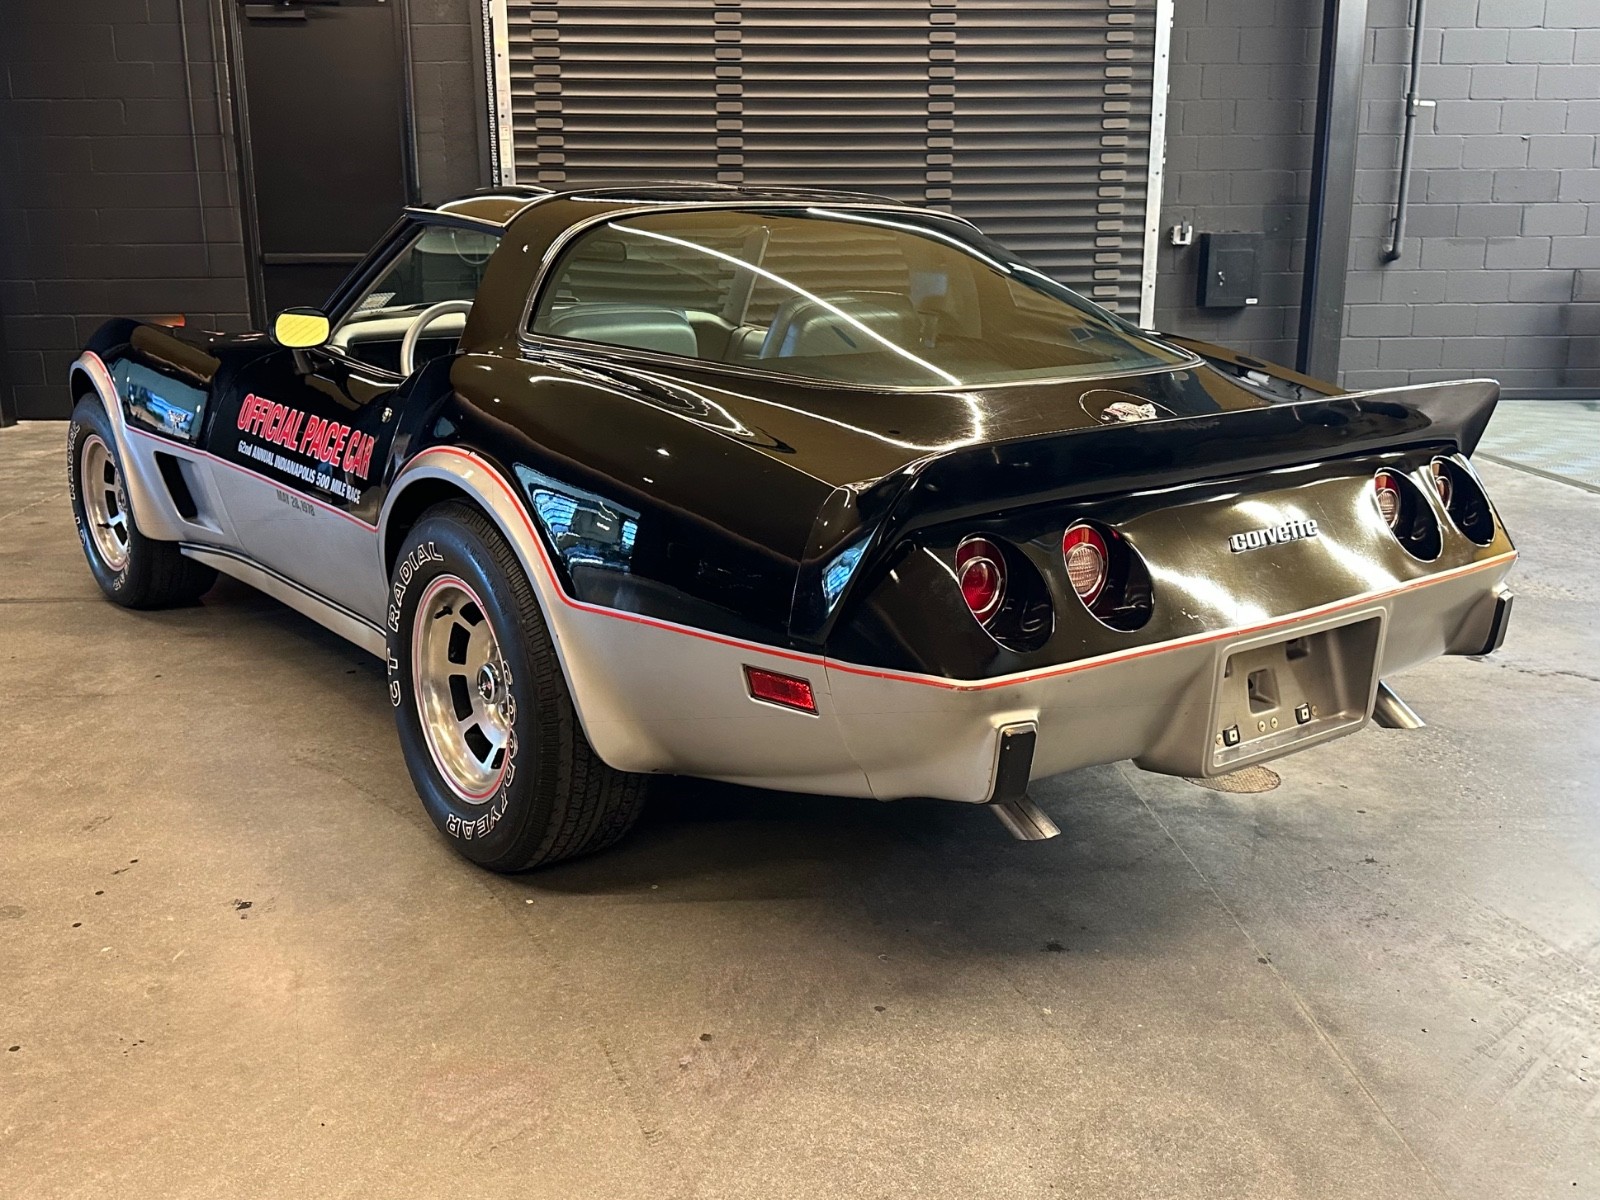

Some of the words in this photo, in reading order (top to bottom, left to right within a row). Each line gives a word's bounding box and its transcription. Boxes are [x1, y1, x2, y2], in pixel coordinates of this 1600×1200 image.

[237, 393, 305, 451] OFFICIAL
[300, 414, 352, 467] PACE
[342, 430, 375, 480] CAR
[237, 439, 254, 456] 62nd
[251, 445, 275, 466] ANNUAL
[274, 454, 317, 484] INDIANAPOLIS
[315, 472, 331, 489] 500
[329, 478, 347, 498] MILE
[345, 485, 361, 504] RACE
[387, 541, 444, 633] RADIAL
